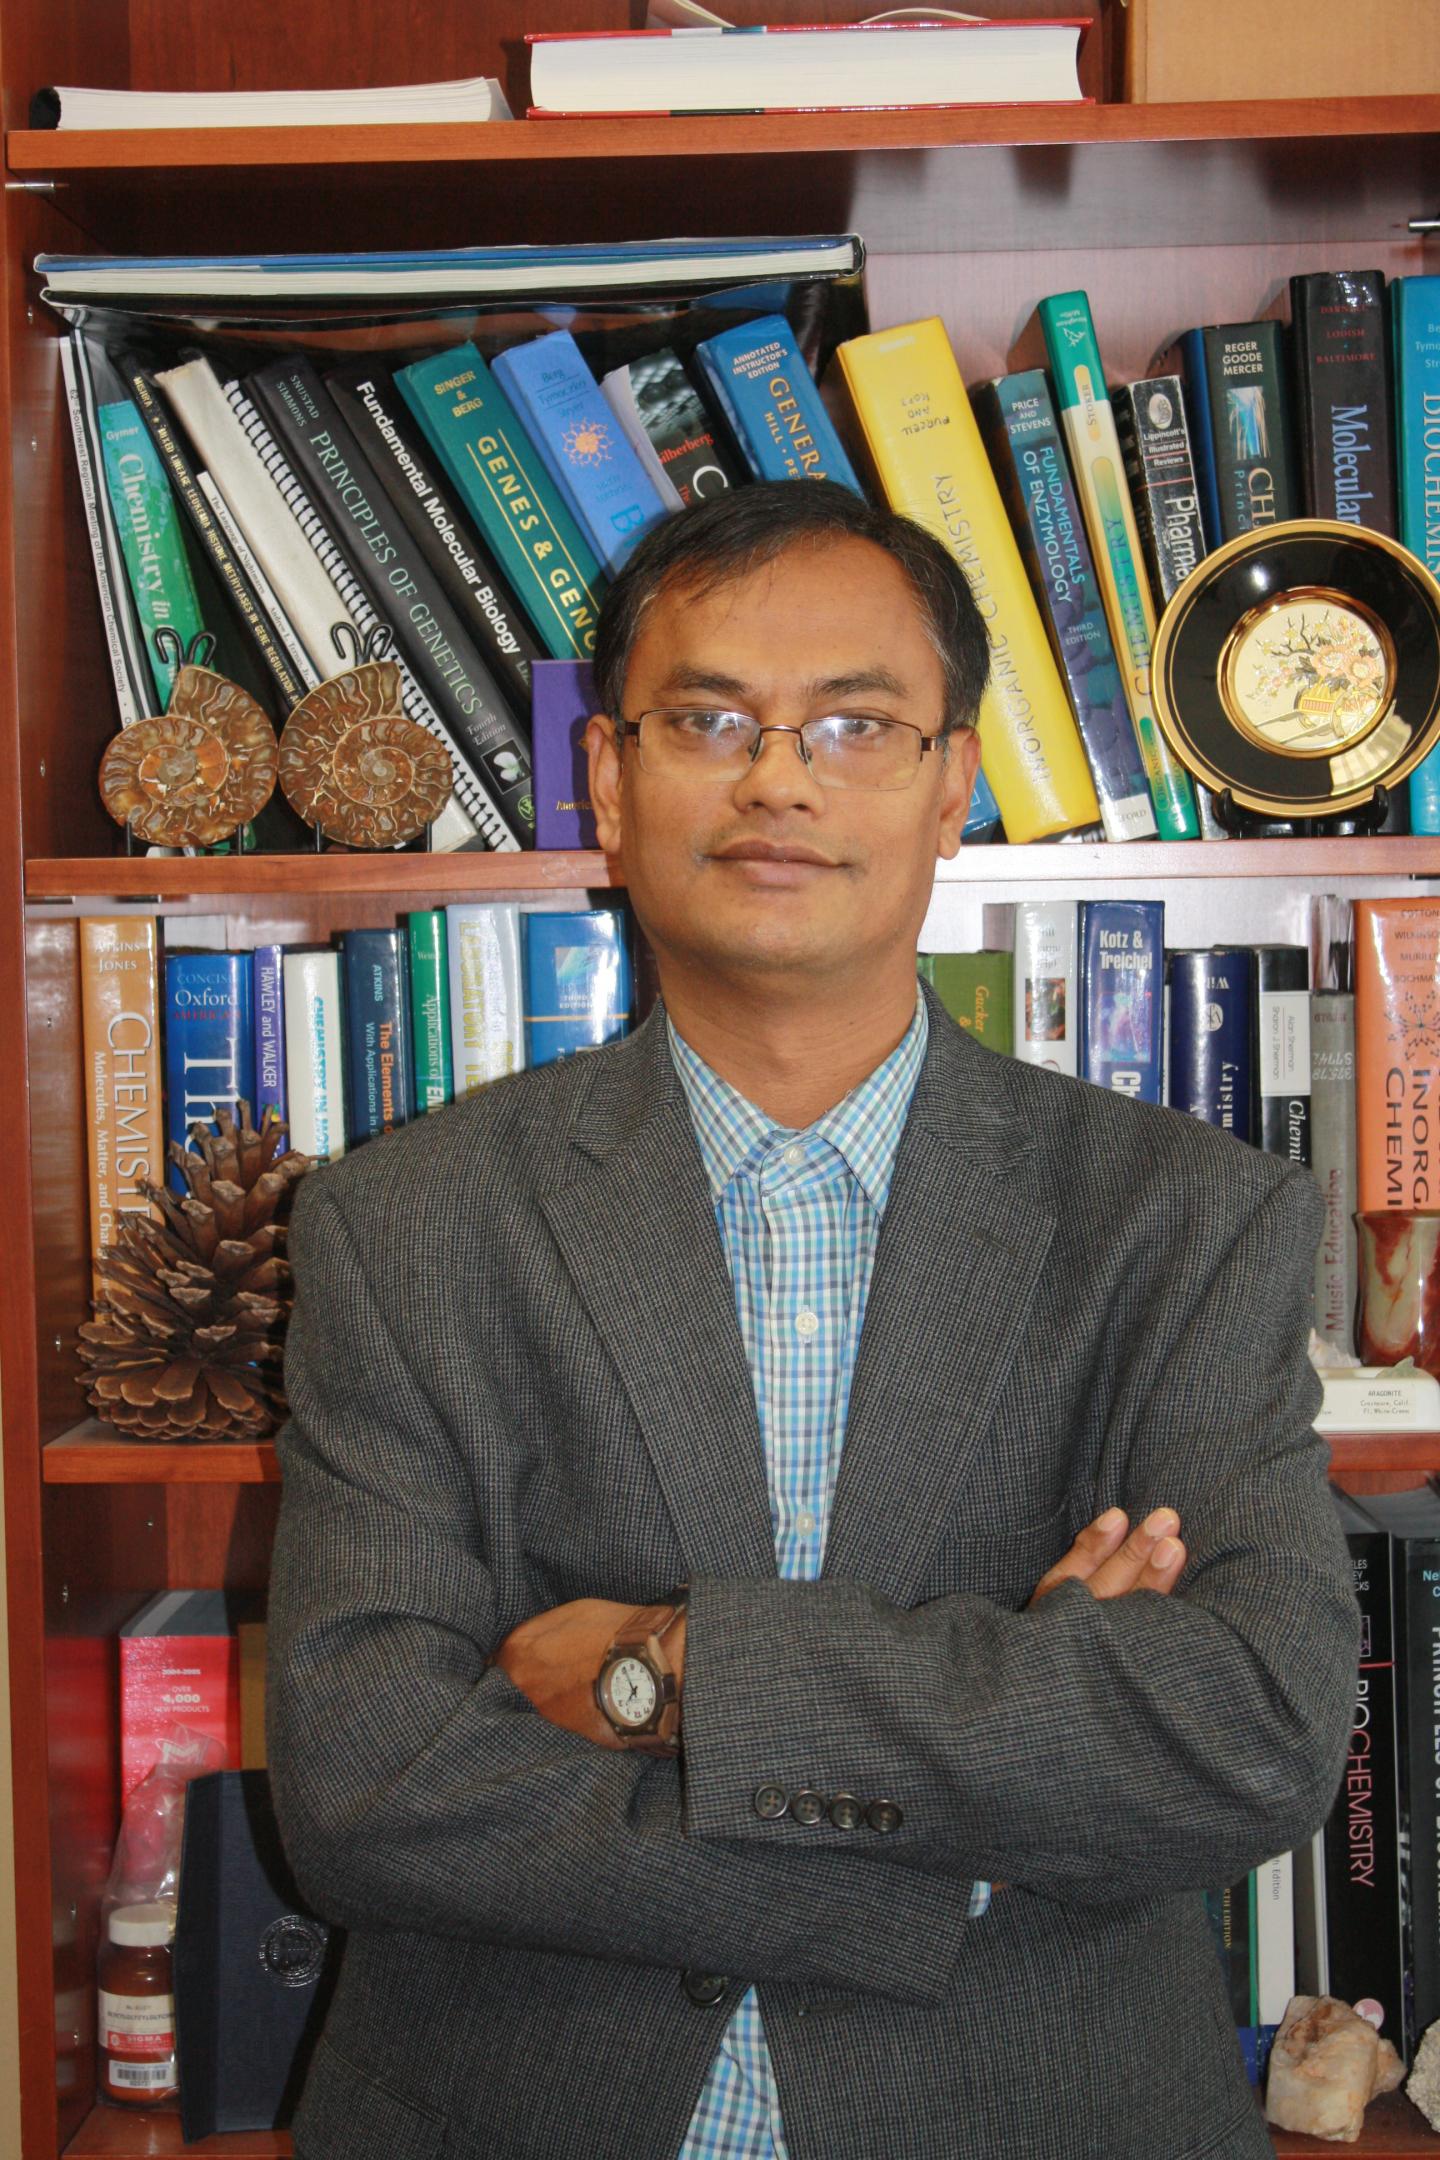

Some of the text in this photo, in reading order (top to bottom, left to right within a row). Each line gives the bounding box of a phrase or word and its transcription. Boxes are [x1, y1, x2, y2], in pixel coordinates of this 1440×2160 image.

[732, 348, 788, 375] INSTRUCTOR'S
[733, 342, 780, 365] ANNOTATED
[1222, 352, 1262, 365] GOODE
[1224, 341, 1258, 354] REGER
[1316, 353, 1376, 363] BALTIMORE
[434, 371, 476, 395] SINGER
[748, 362, 780, 379] EDITION
[1223, 363, 1264, 377] MERCER
[277, 381, 307, 427] SIMMONS
[290, 374, 320, 419] SNUSTAD
[452, 398, 483, 417] BERG
[456, 390, 468, 401] &
[1011, 398, 1039, 411] PRICE
[764, 411, 783, 445] HILL
[1010, 417, 1051, 434] STEVENS
[1019, 410, 1037, 419] AND
[72, 409, 88, 460] Southwest
[106, 426, 139, 441] Gymer
[1143, 428, 1185, 442] Lippincott's
[1149, 442, 1184, 453] Illustrated
[1154, 456, 1184, 467] Reviews
[1331, 404, 1374, 524] Molecular
[80, 459, 94, 499] Regional
[478, 436, 539, 531] GENES
[533, 541, 553, 561] &
[87, 503, 99, 540] Meeting
[356, 381, 521, 655] Fundamental Molecular Biology
[1023, 450, 1072, 603] OF ENZYMOLOGY
[1040, 446, 1085, 584] FUNDAMENTALS
[118, 453, 165, 594] Chemistry
[152, 600, 171, 619] in
[95, 551, 105, 571] the
[170, 454, 192, 487] LINEAGE
[223, 563, 254, 613] METHYLASES
[249, 613, 258, 625] IN
[254, 625, 272, 647] GENE
[266, 645, 296, 694] REGULATION
[242, 552, 266, 594] Nightmares
[309, 430, 483, 715] PRINCIPLES OF GENETICS
[98, 571, 112, 613] American
[106, 614, 120, 658] Chemical
[934, 472, 1050, 783] INORGANIC CHEMISTRY
[1065, 631, 1100, 645] EDITION
[1067, 621, 1094, 634] THIRD
[114, 658, 126, 693] Society
[466, 712, 497, 736] Fourth
[473, 724, 506, 746] Edition
[1100, 930, 1143, 949] Kotz &
[1394, 931, 1440, 940] WILKINSO
[99, 960, 137, 972] JONES
[1099, 951, 1152, 970] Treichel
[175, 987, 239, 1007] Oxford
[373, 965, 384, 1002] ATKINS
[959, 1016, 972, 1028] &
[976, 985, 989, 1033] Gucker
[1272, 1006, 1281, 1035] Sharon
[260, 967, 277, 1088] HAWLEY and WALKER
[366, 1023, 375, 1047] With
[379, 1024, 393, 1050] The
[421, 994, 438, 1068] Applications
[1272, 1043, 1281, 1080] Sherman
[1288, 1036, 1296, 1072] Sherman
[94, 1051, 106, 1125] Molecules,
[365, 1051, 377, 1112] Applications
[380, 1053, 394, 1121] Elements
[369, 1114, 379, 1126] in
[97, 1129, 110, 1178] Matter,
[98, 1181, 110, 1208] and
[1324, 1169, 1345, 1331] Music Education
[163, 1694, 201, 1704] 4,000
[1272, 1869, 1282, 1901] Edition
[1223, 1909, 1232, 1950] EDITION
